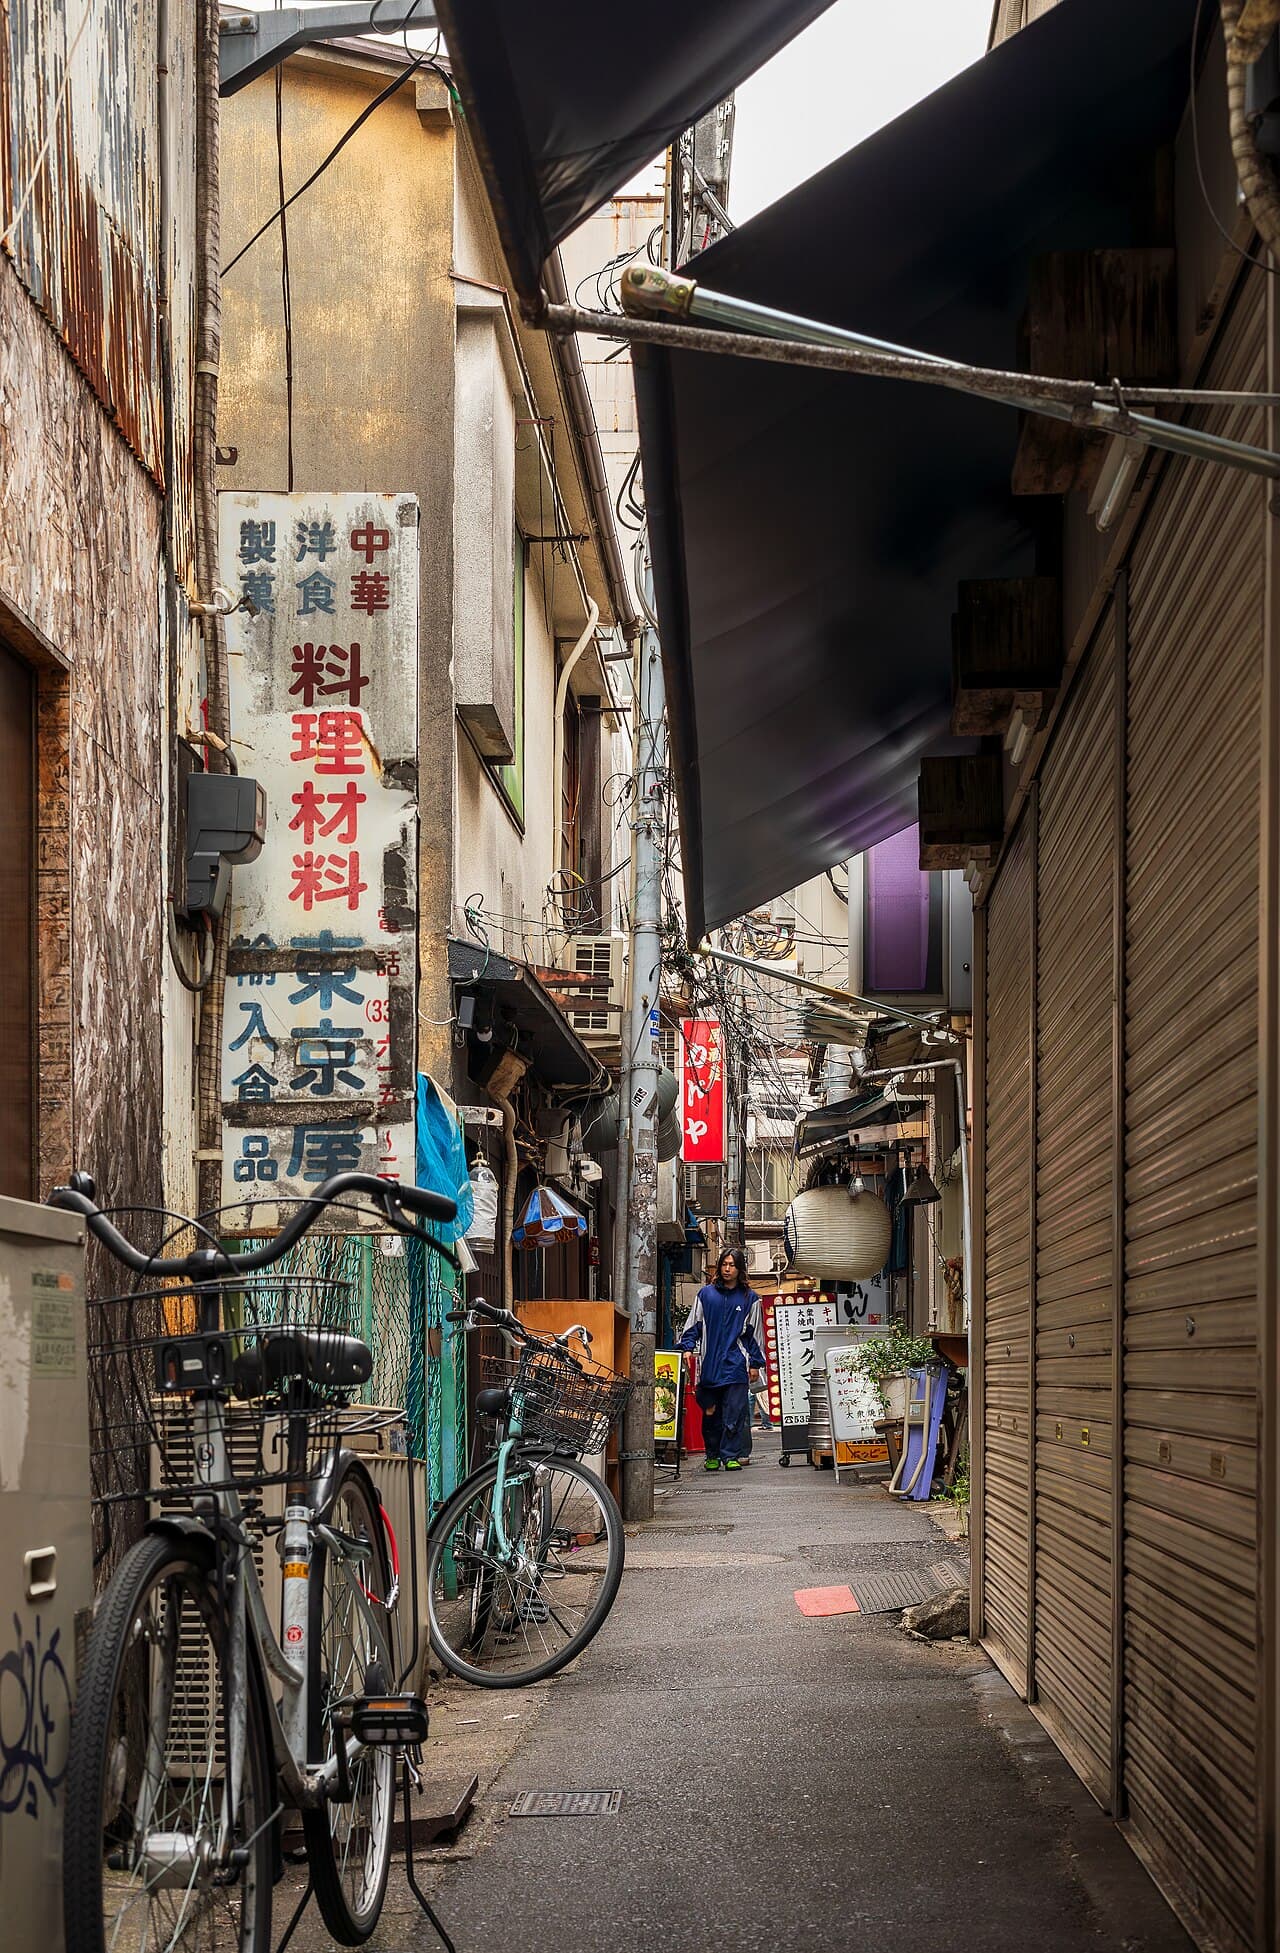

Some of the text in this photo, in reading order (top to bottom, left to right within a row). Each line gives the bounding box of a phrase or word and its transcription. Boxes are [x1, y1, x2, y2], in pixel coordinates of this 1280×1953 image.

[295, 521, 337, 615] 洋食
[351, 521, 390, 616] 中華
[287, 642, 370, 911] 料理材料
